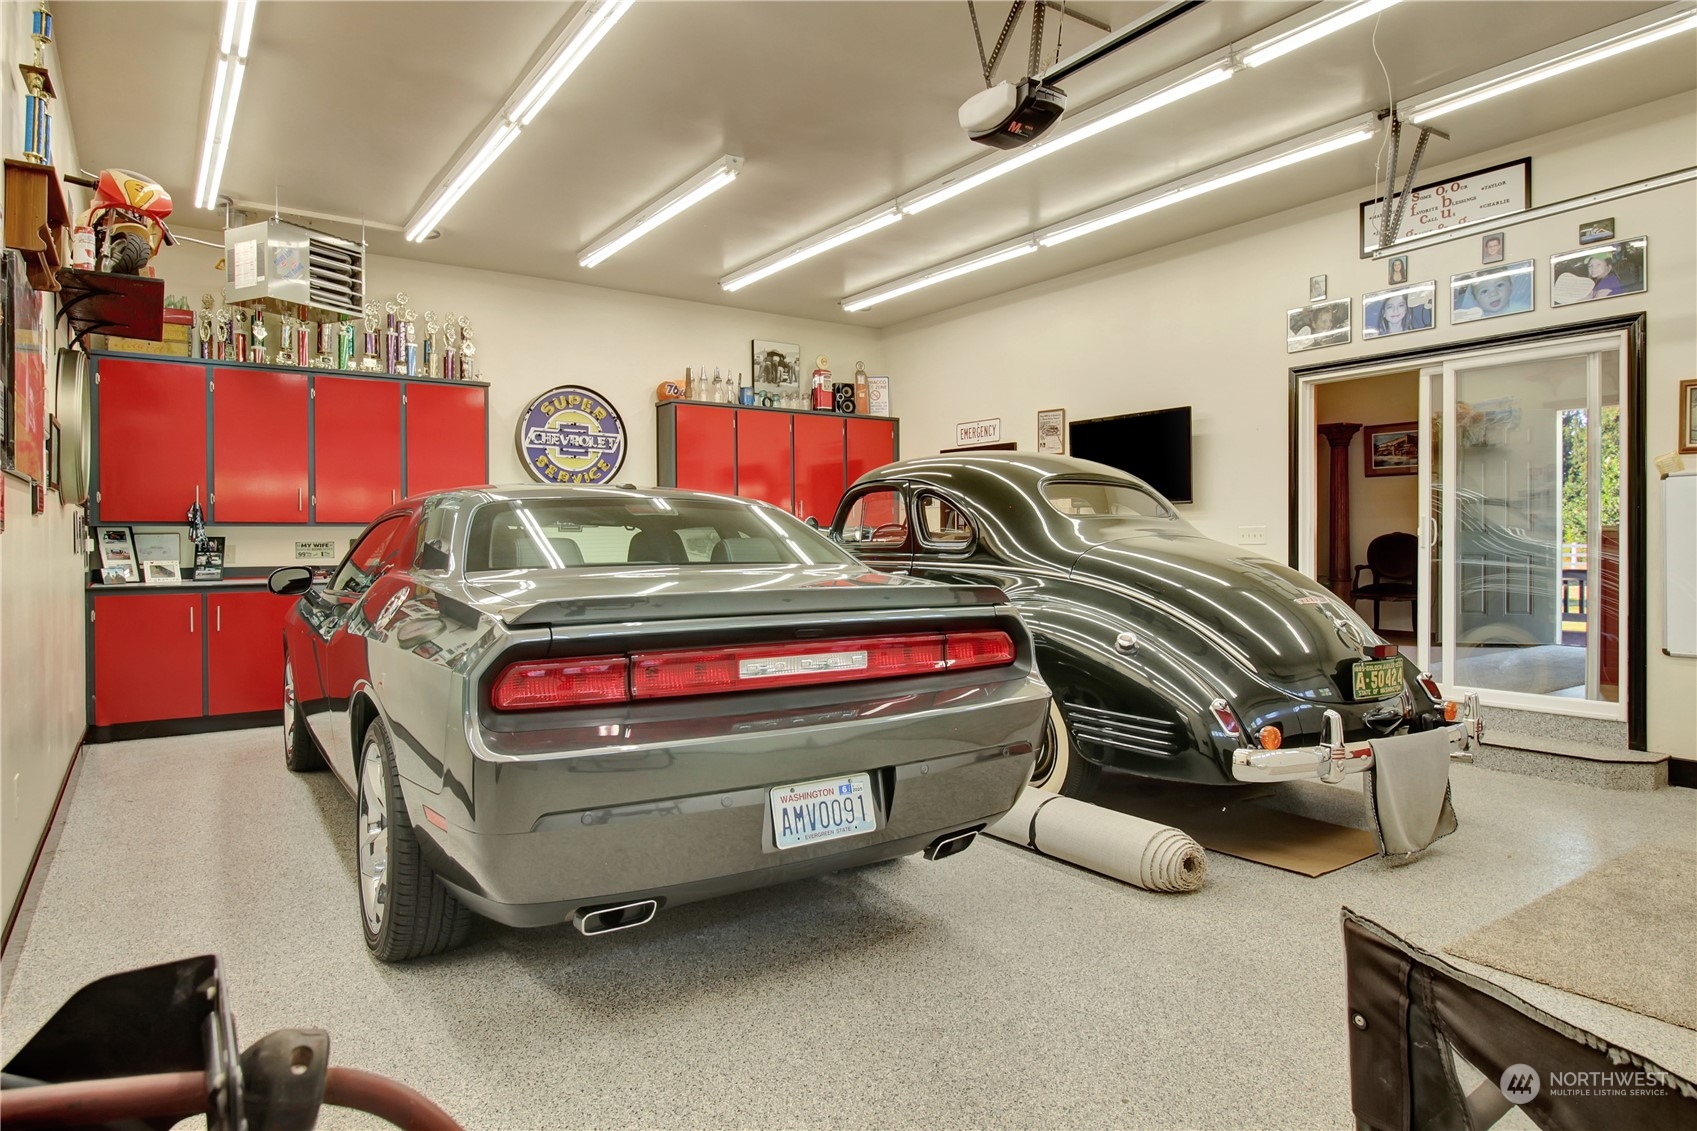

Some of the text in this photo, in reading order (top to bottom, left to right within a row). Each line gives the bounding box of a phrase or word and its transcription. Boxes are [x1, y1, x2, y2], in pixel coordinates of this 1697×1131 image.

[1484, 181, 1507, 190] TAYLOR
[1483, 198, 1510, 208] CHARLIE
[666, 384, 679, 396] 76
[540, 395, 607, 420] SUPER
[531, 432, 616, 448] CHEVROLET
[960, 424, 997, 440] EMERGENCY
[536, 456, 610, 484] SERVICE
[780, 787, 835, 804] WASHINGTON
[782, 794, 866, 837] AMV0091
[804, 826, 852, 840] EVERGREEN STATE
